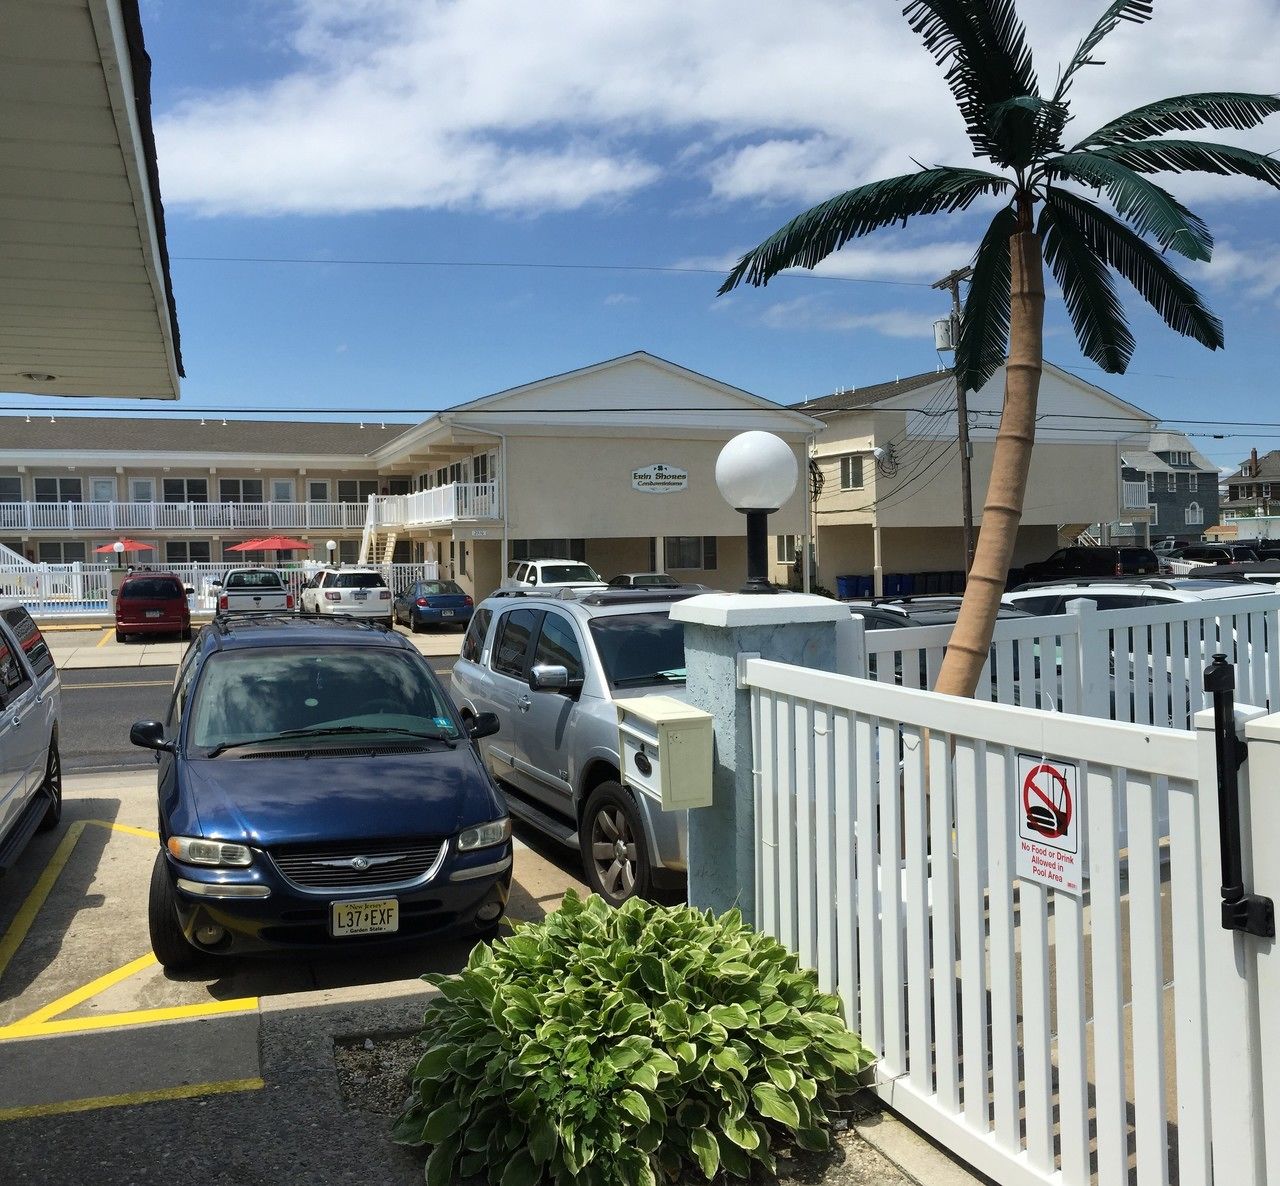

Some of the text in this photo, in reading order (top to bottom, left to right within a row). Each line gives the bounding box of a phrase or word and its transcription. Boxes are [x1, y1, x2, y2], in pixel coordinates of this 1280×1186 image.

[633, 472, 686, 480] Erin Shores
[1021, 841, 1030, 852] No
[1031, 844, 1047, 856] Food
[1056, 852, 1074, 864] Drink
[1031, 855, 1064, 872] Allowed in
[1032, 866, 1063, 883] Pool Area
[338, 908, 394, 928] L37 EXF
